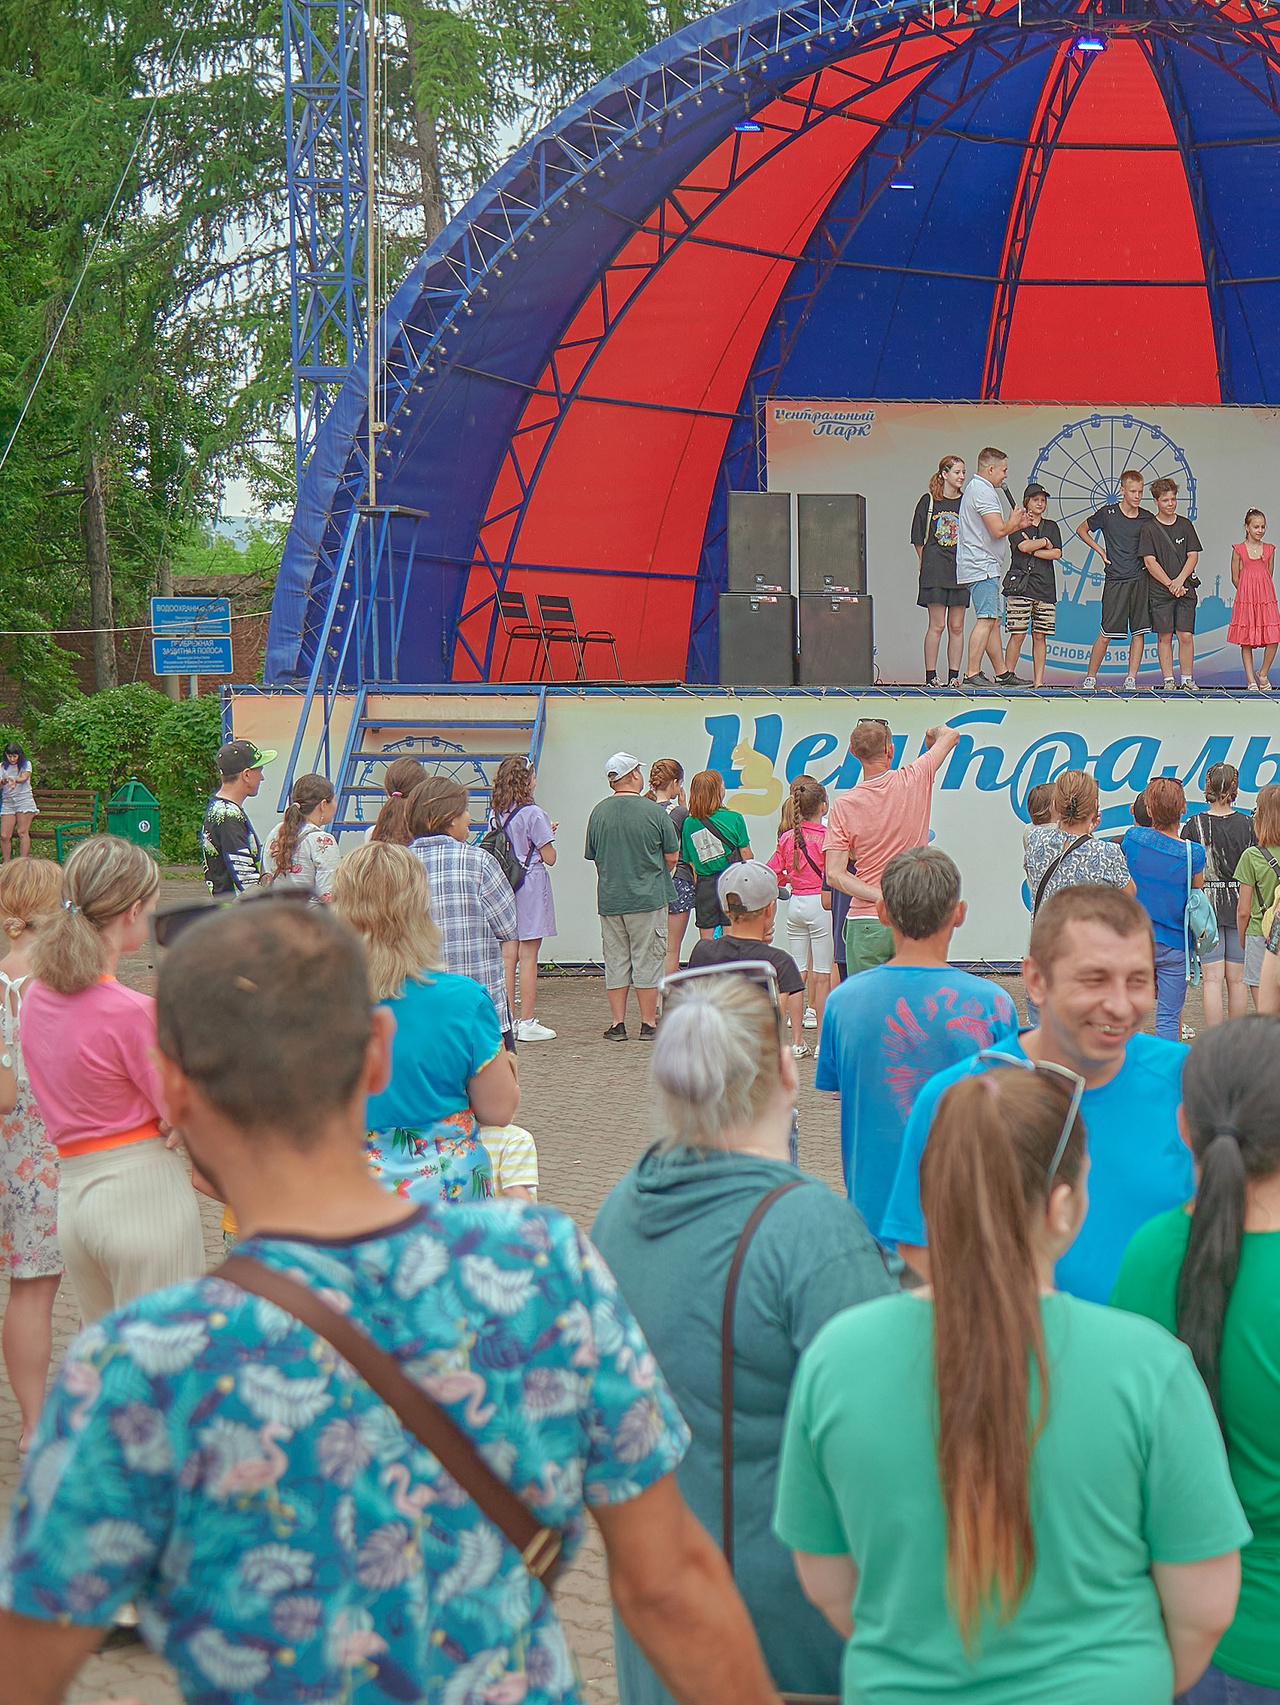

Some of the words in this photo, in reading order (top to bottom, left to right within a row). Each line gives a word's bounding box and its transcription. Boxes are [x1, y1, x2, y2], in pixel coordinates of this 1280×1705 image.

[775, 409, 875, 424] Центральный
[813, 421, 871, 441] Парк
[197, 647, 224, 655] ПОЛОСА
[1046, 644, 1091, 661] ОСНОВА
